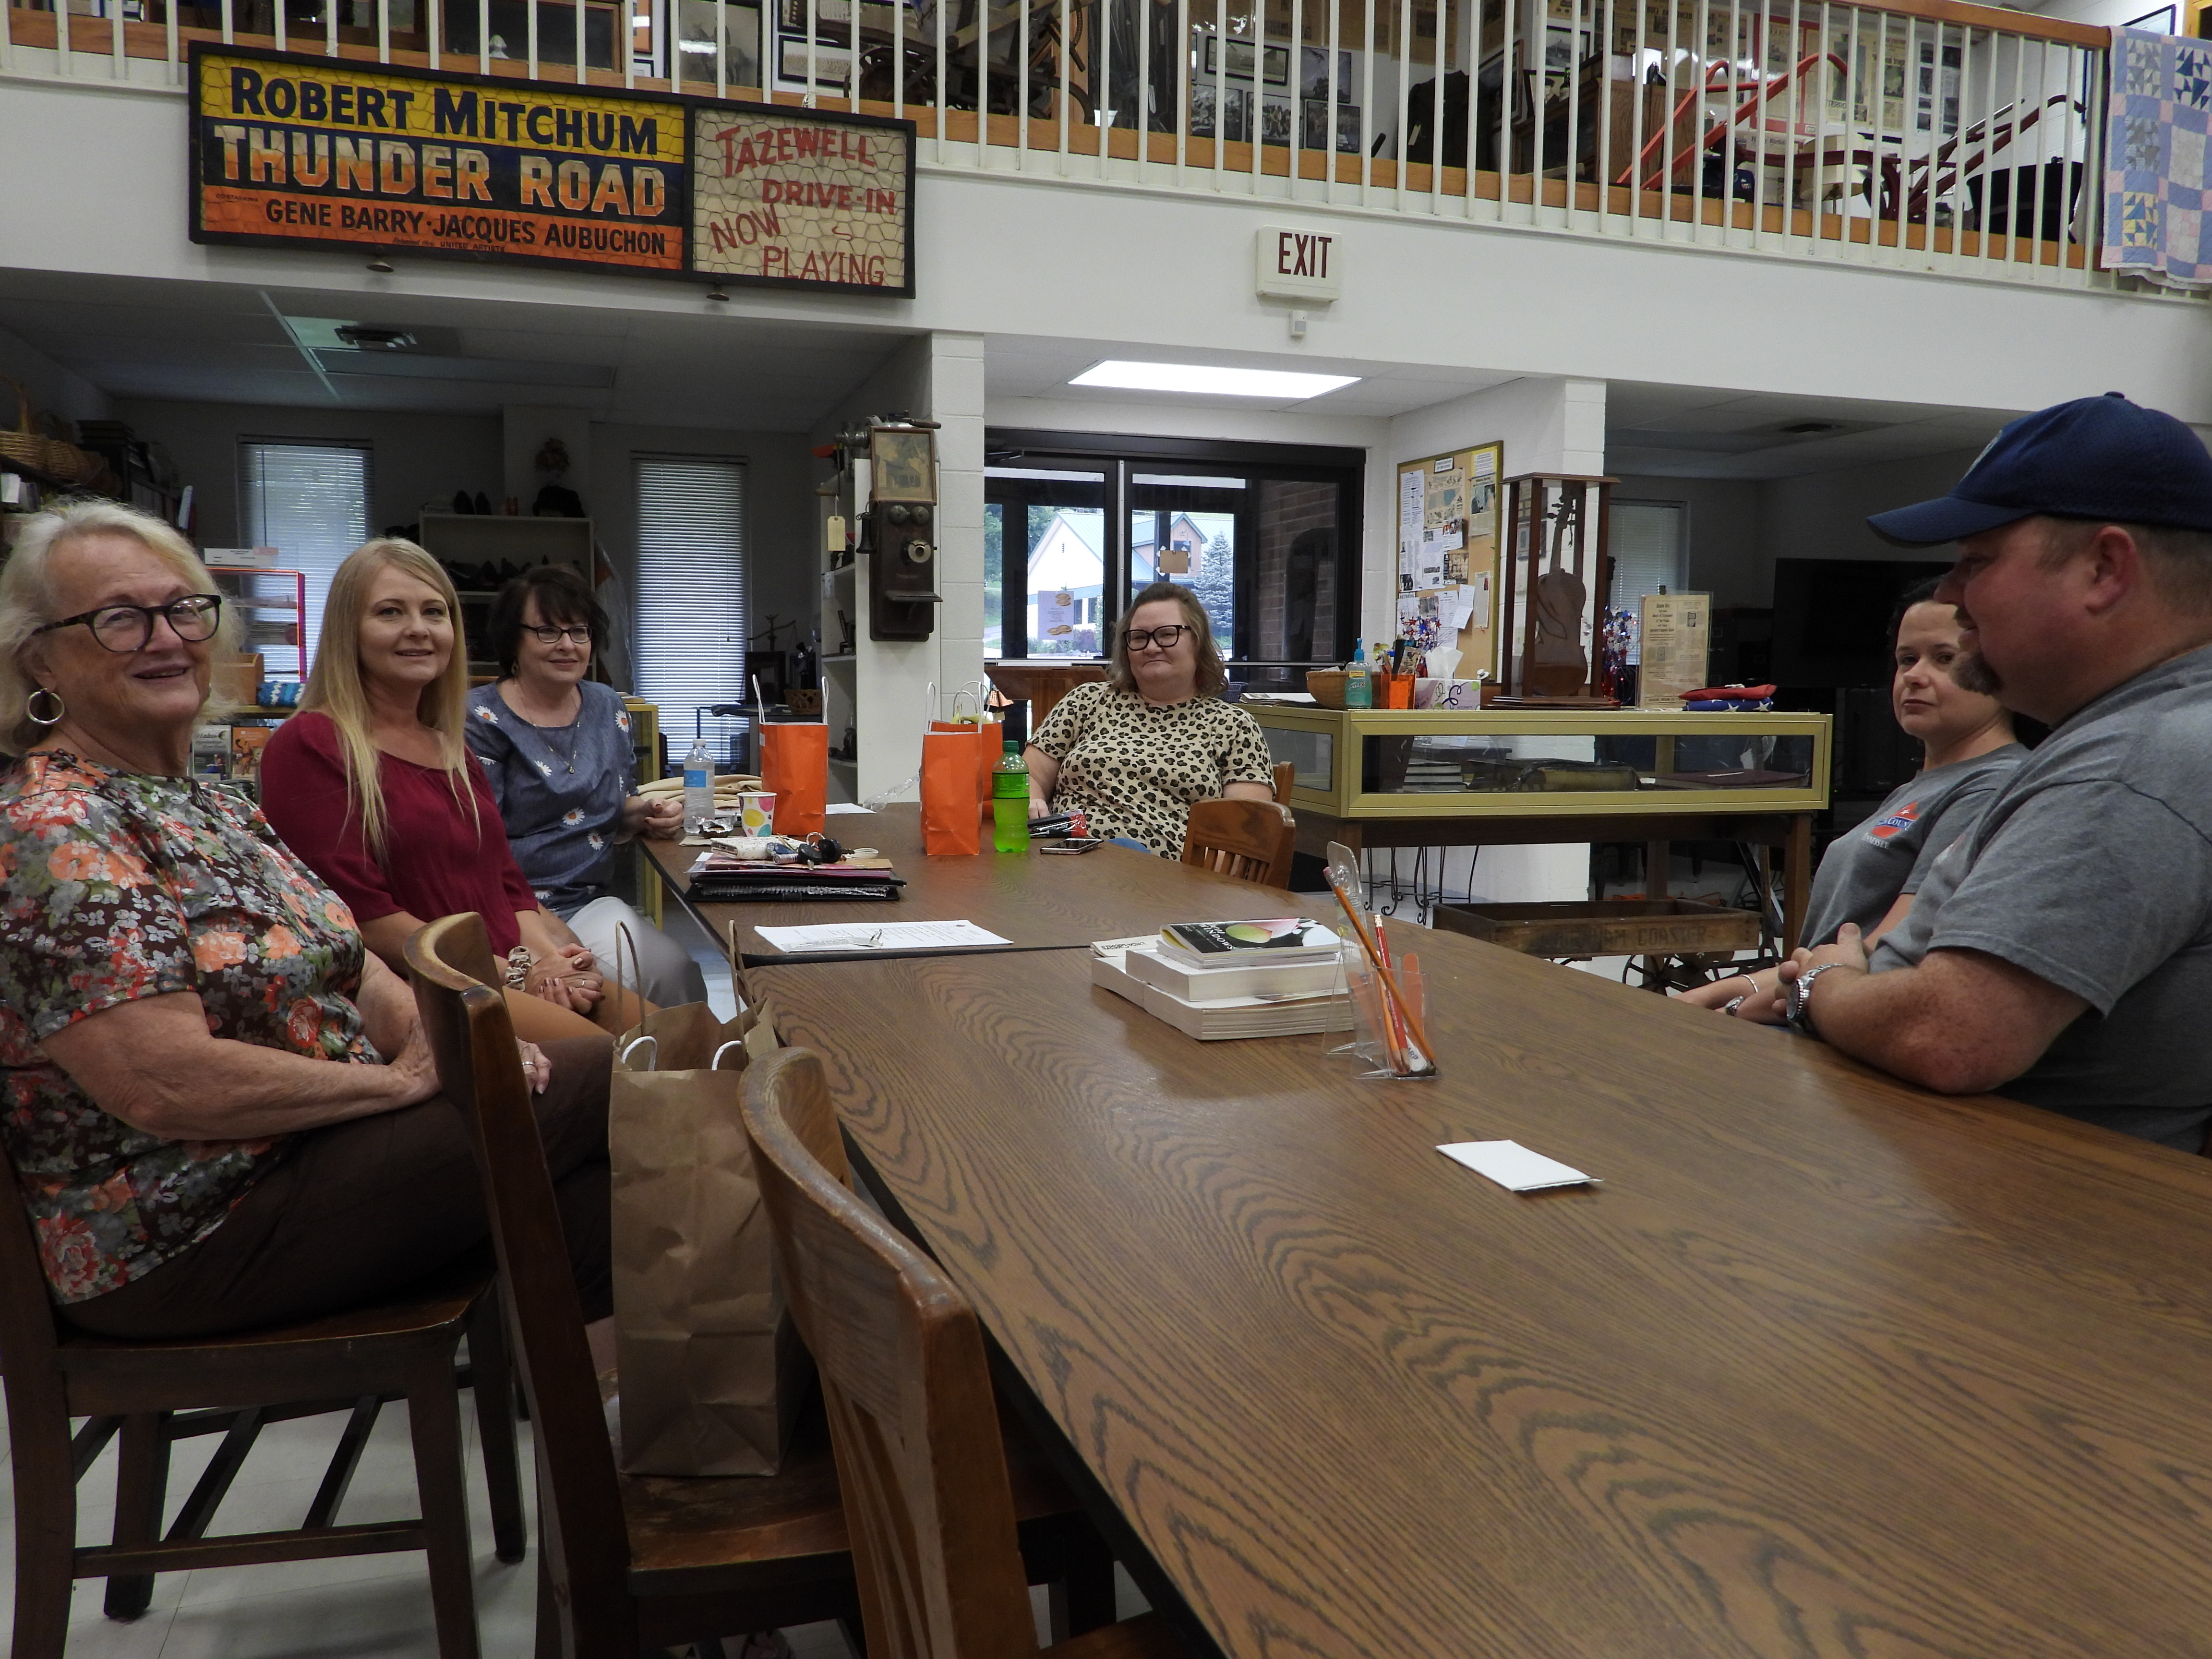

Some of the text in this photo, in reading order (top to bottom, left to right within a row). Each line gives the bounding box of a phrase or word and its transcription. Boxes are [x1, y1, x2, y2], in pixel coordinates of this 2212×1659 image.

[231, 67, 658, 155] ROBERT MITCHUM
[214, 124, 665, 217] THUNDER ROAD
[716, 125, 875, 179] TAZEWELL
[266, 199, 331, 227] GENE
[544, 223, 665, 255] AUBUCHON
[710, 204, 781, 254] NOW
[763, 245, 885, 286] PLAYING
[1278, 232, 1332, 278] EXIT
